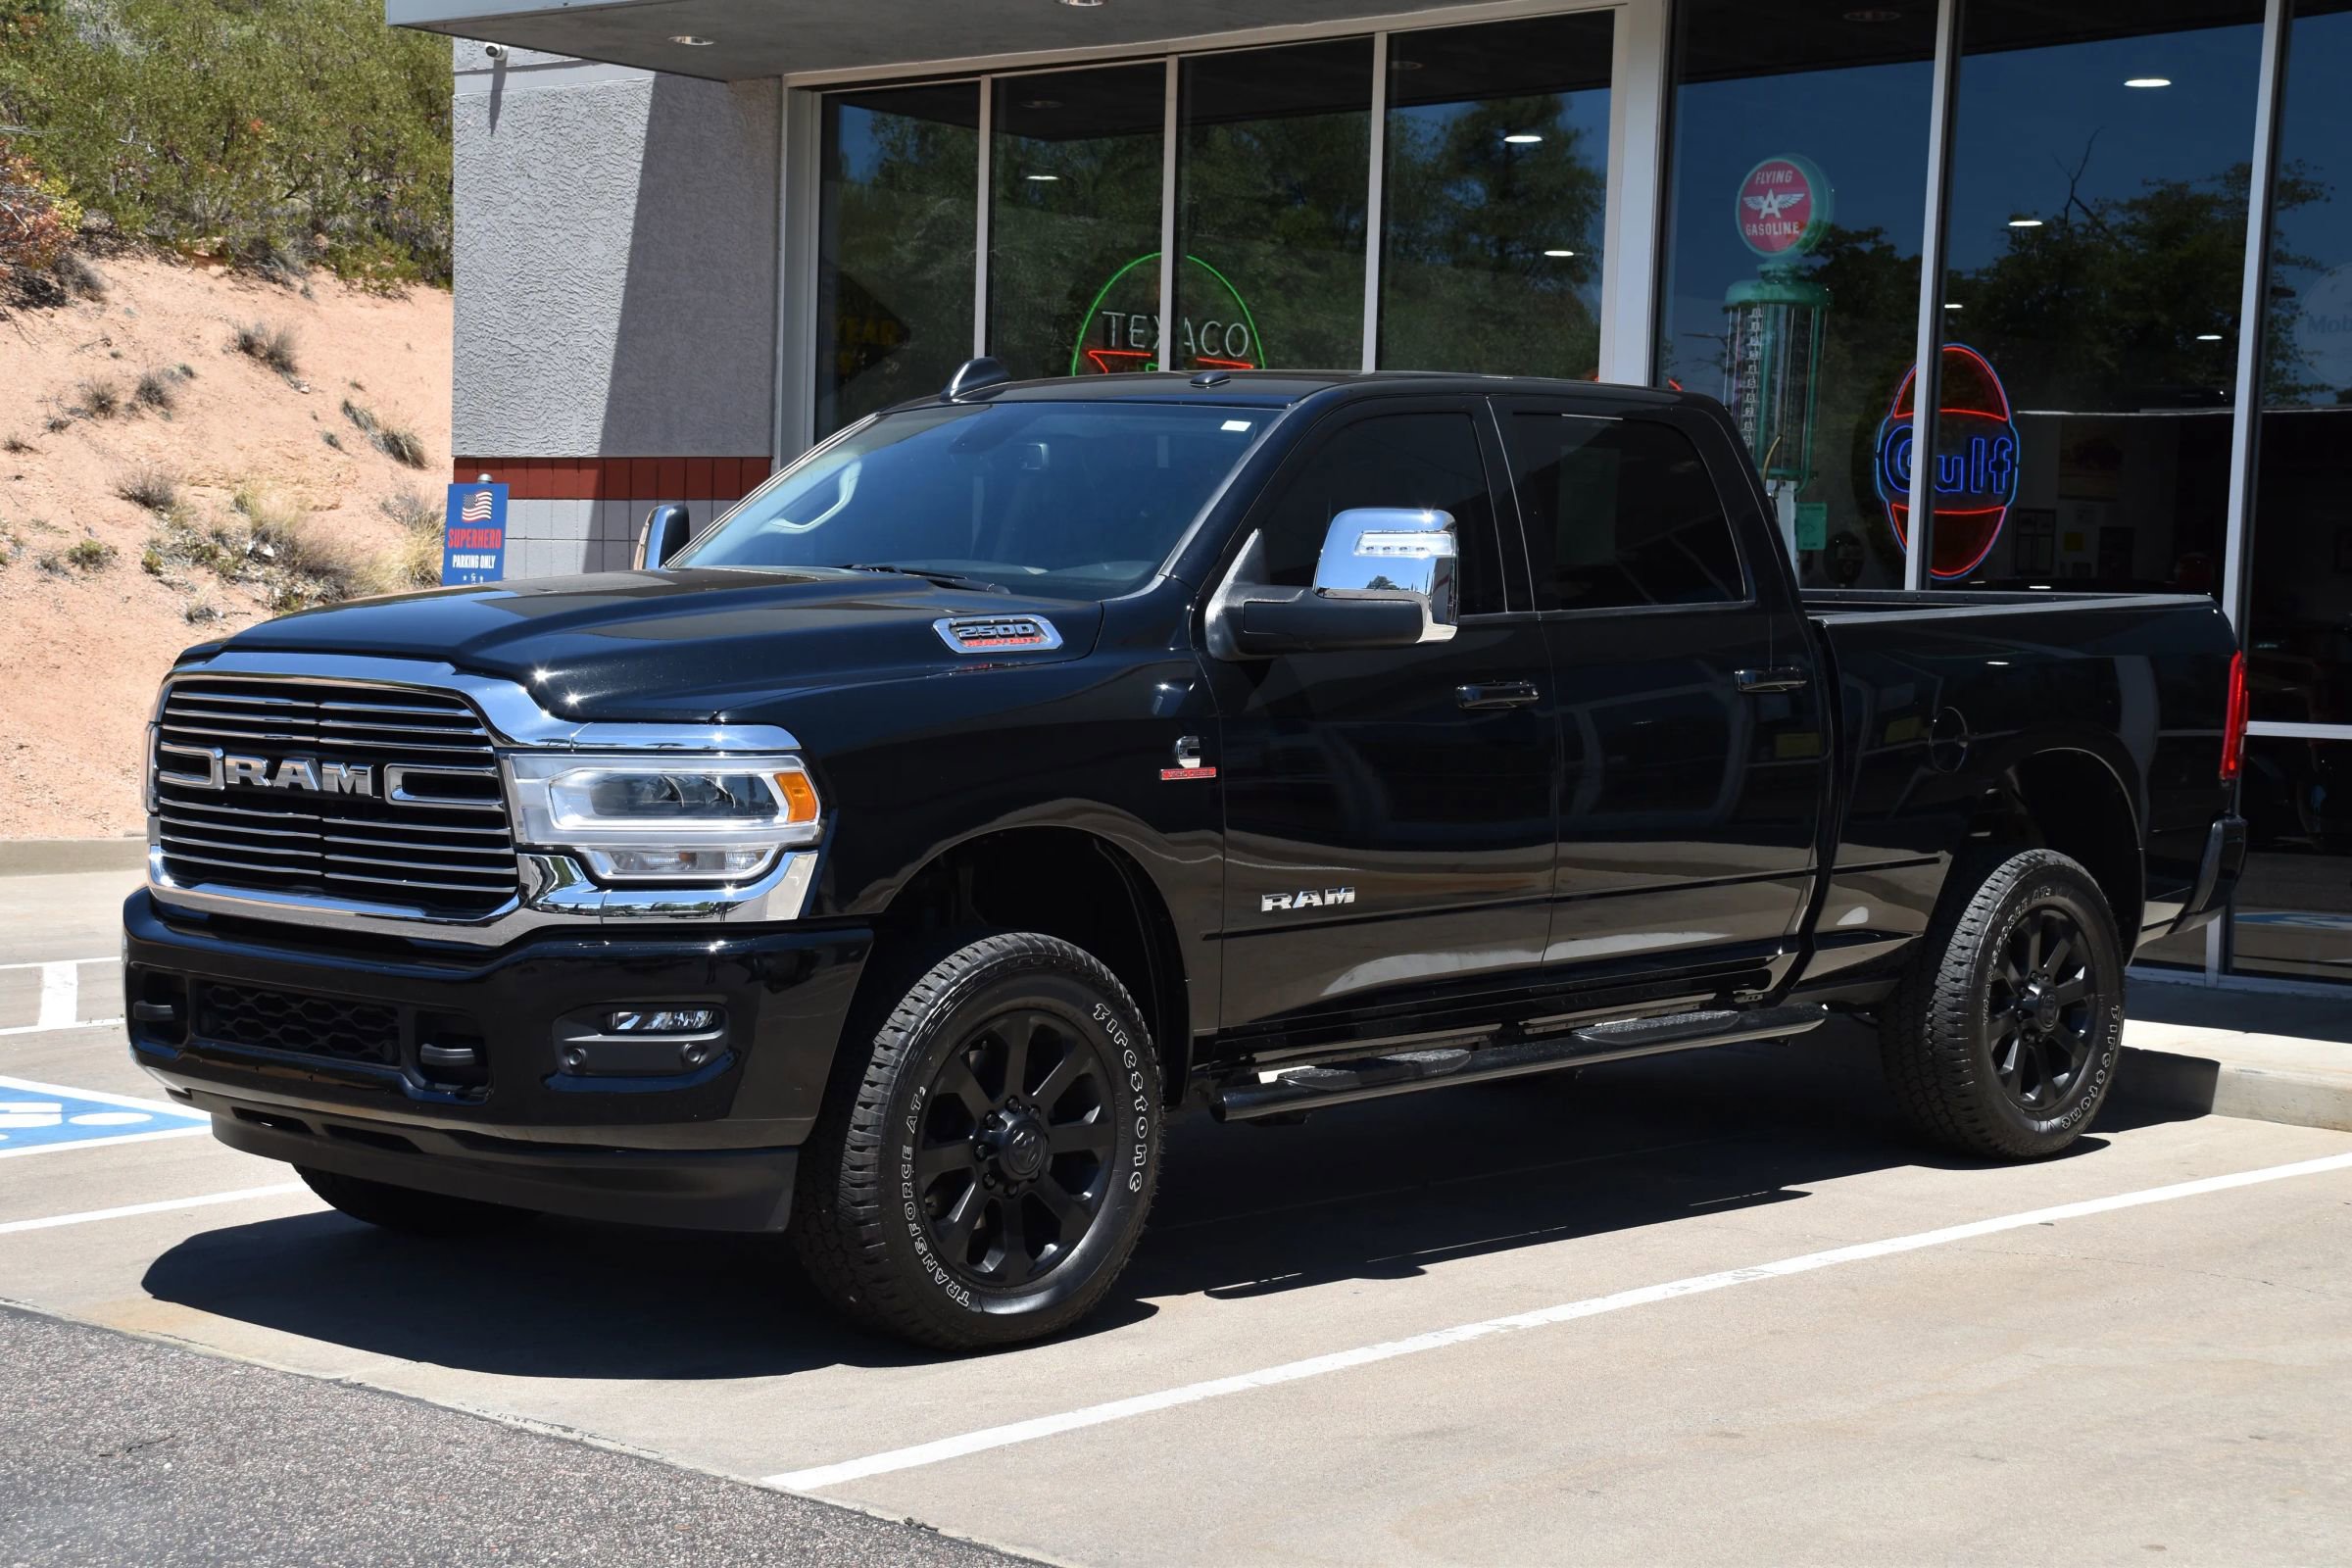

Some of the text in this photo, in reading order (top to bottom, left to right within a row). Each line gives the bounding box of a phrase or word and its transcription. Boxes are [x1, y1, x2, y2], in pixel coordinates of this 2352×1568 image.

[1755, 170, 1792, 184] FLYING
[1745, 221, 1800, 236] GASOLINE
[448, 528, 502, 549] SUPERHERO
[453, 555, 496, 568] PARKING ONLY
[956, 623, 1036, 641] 2500
[222, 752, 363, 793] RAM
[1260, 886, 1356, 912] RAM
[1983, 896, 2029, 1026] TRANSFORCE
[2060, 1004, 2121, 1130] Firestone
[1092, 1002, 1150, 1193] Firestone
[901, 1145, 971, 1308] TRANSFORCE
